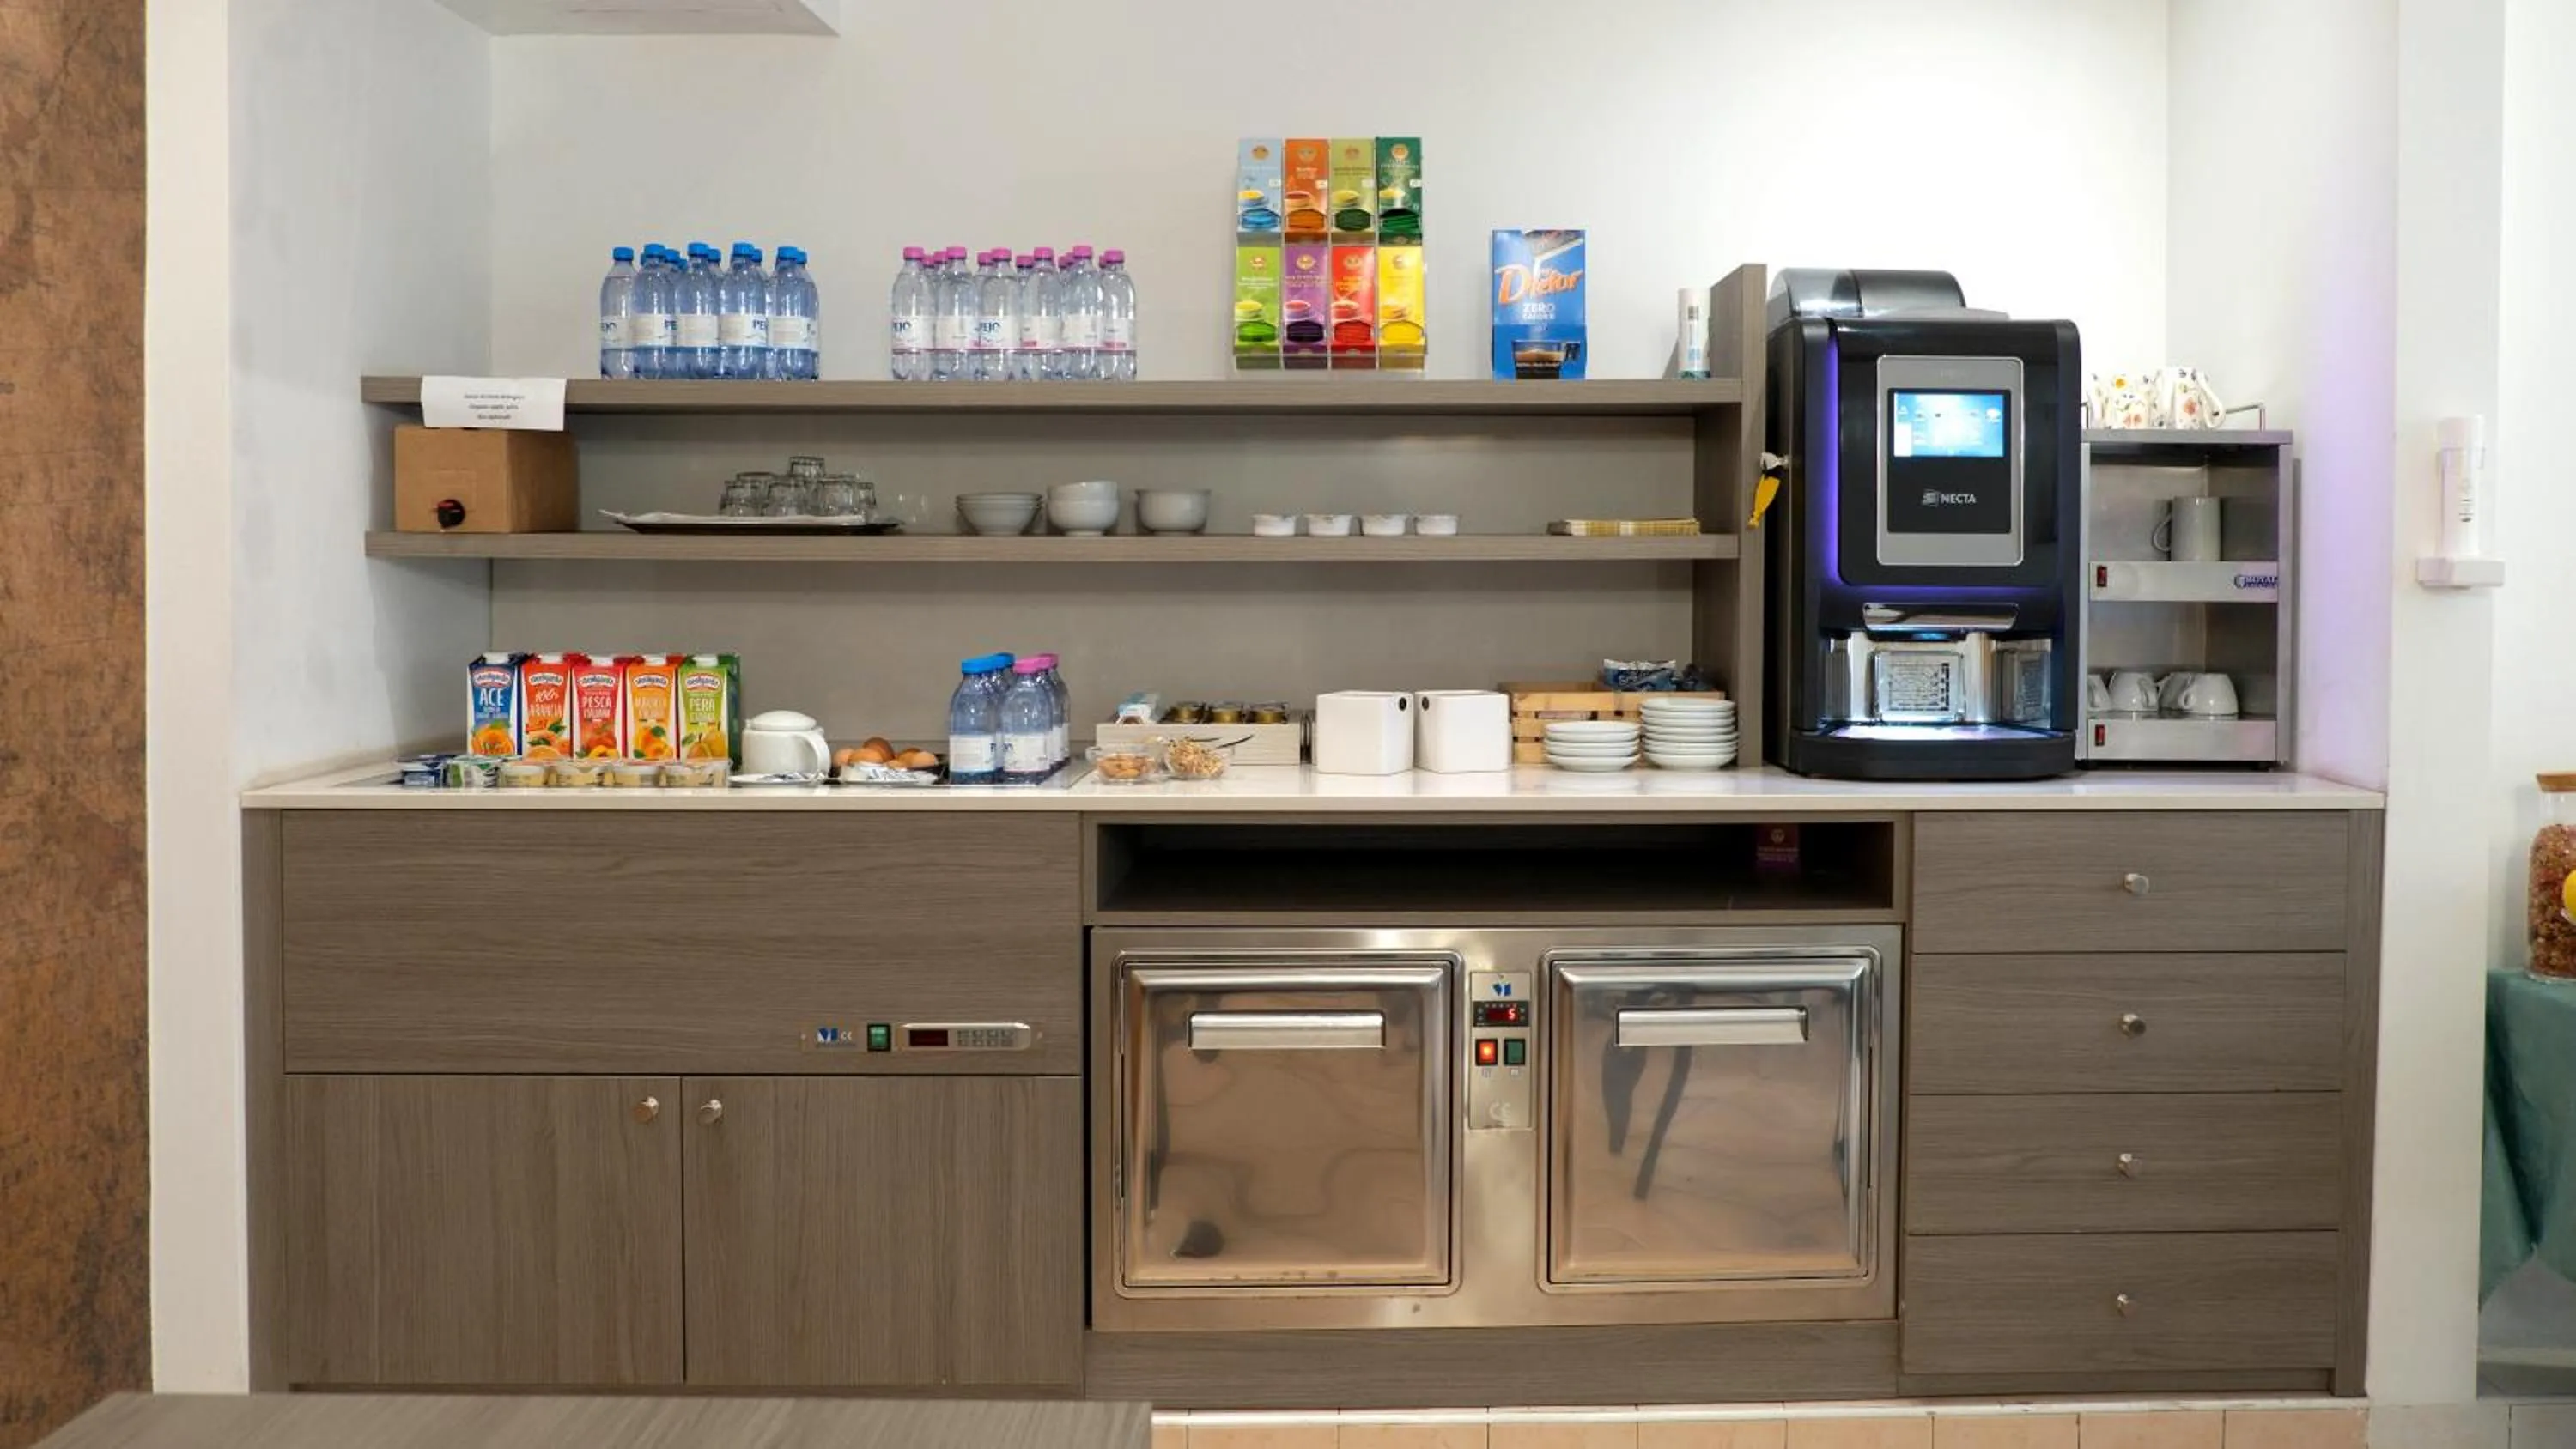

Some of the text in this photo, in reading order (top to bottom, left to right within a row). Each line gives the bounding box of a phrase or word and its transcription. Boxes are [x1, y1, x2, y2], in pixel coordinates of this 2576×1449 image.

[1522, 302, 1555, 313] ZERO
[1941, 494, 1976, 504] NECTA
[480, 688, 504, 706] ACE
[582, 696, 612, 708] PESCA
[690, 698, 714, 712] PERA
